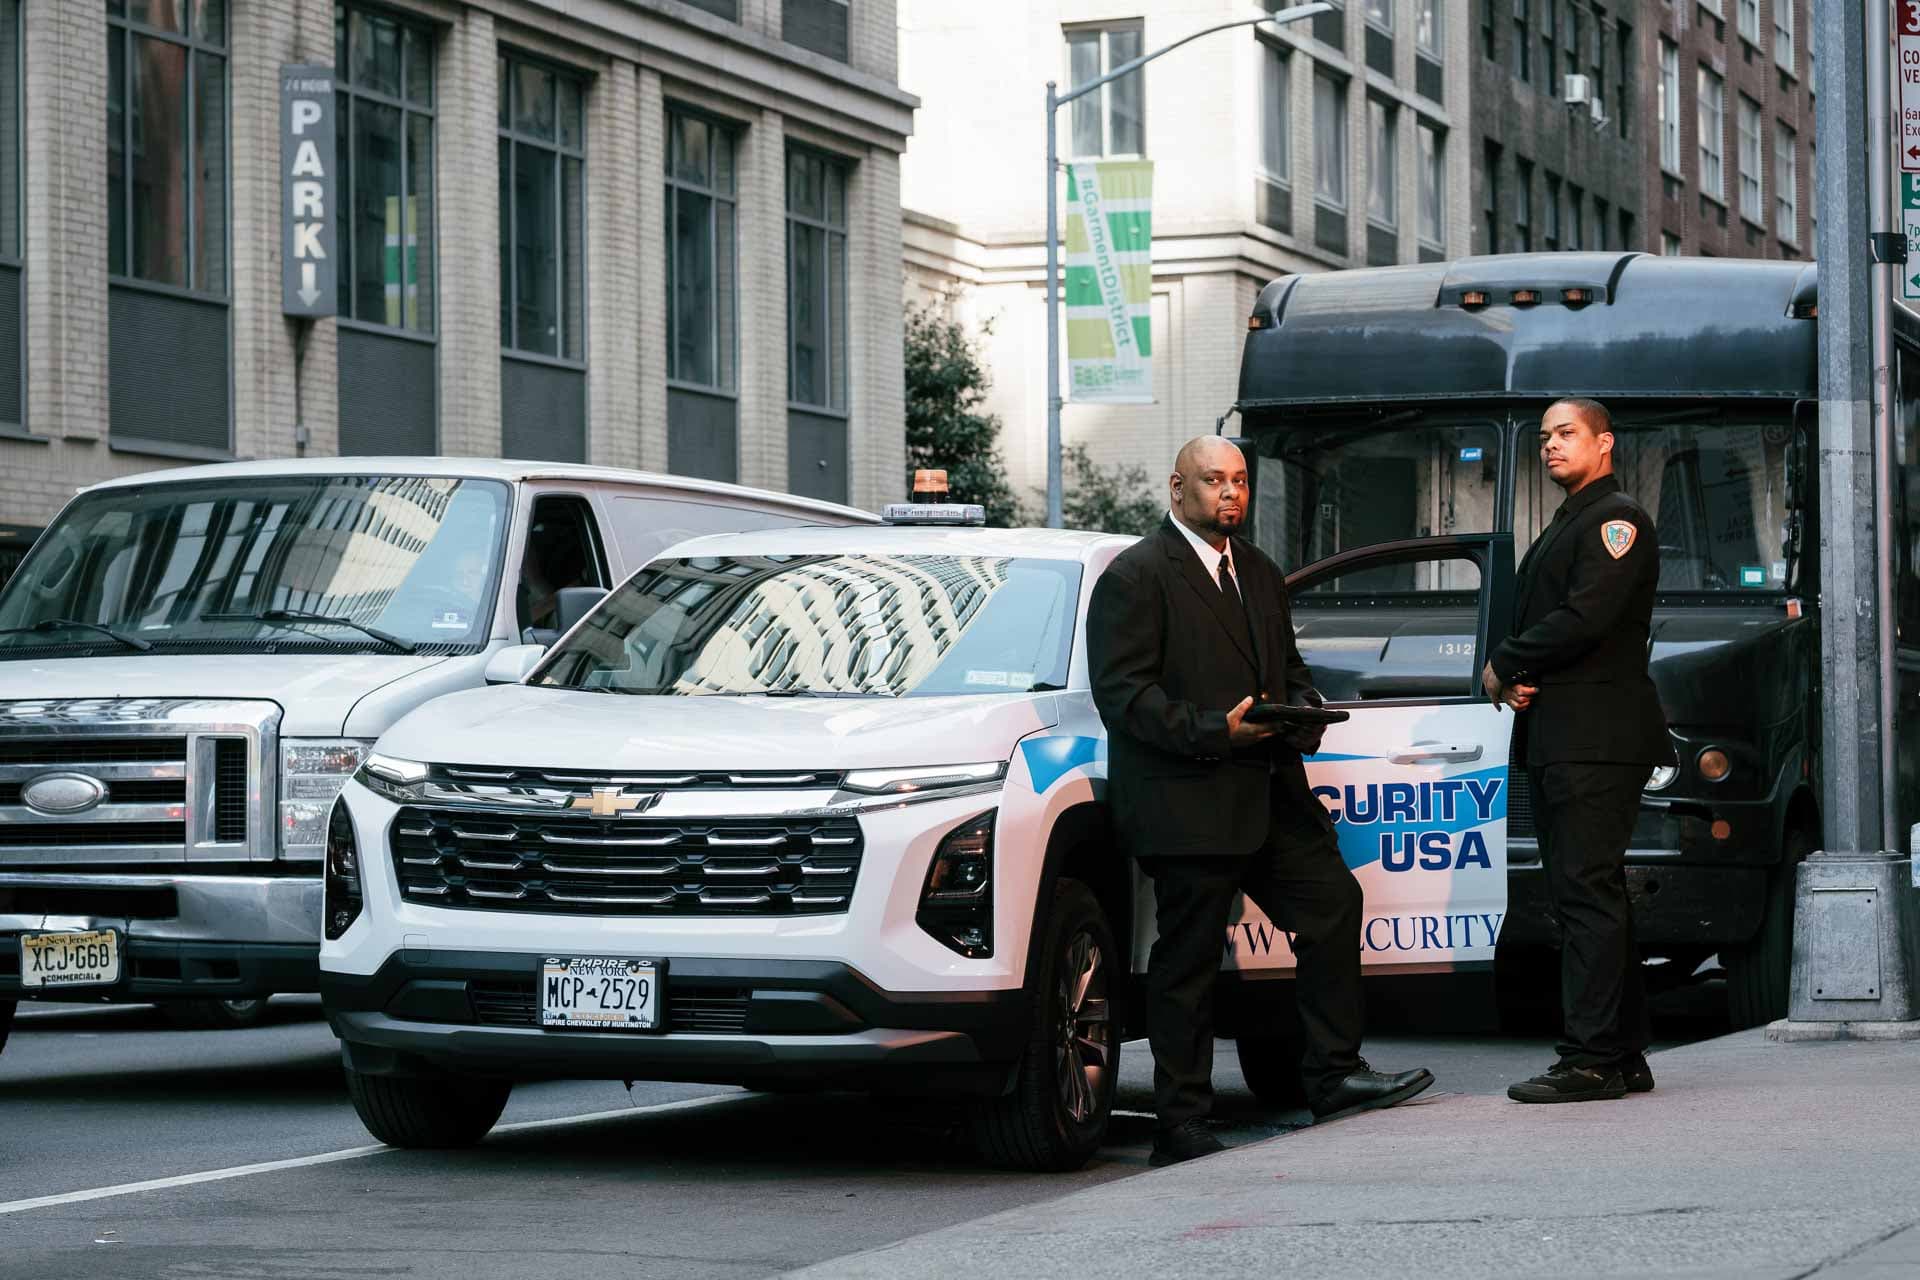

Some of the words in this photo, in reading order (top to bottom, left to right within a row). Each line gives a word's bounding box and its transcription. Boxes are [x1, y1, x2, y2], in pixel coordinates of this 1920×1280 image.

[1906, 0, 1920, 32] 3
[1904, 50, 1920, 64] CO
[1904, 69, 1920, 83] VE
[1905, 108, 1920, 120] 6a
[291, 100, 326, 258] PARK
[1082, 178, 1132, 347] #GarmentDistrict
[1439, 643, 1475, 655] 1312
[1380, 831, 1492, 872] USA
[46, 936, 65, 945] New
[69, 933, 94, 945] Jersey
[1360, 913, 1503, 951] CURITY
[570, 958, 629, 968] EMPIRE
[46, 973, 95, 983] COMMERCIAL
[570, 967, 594, 976] NEW
[600, 967, 629, 977] YORK
